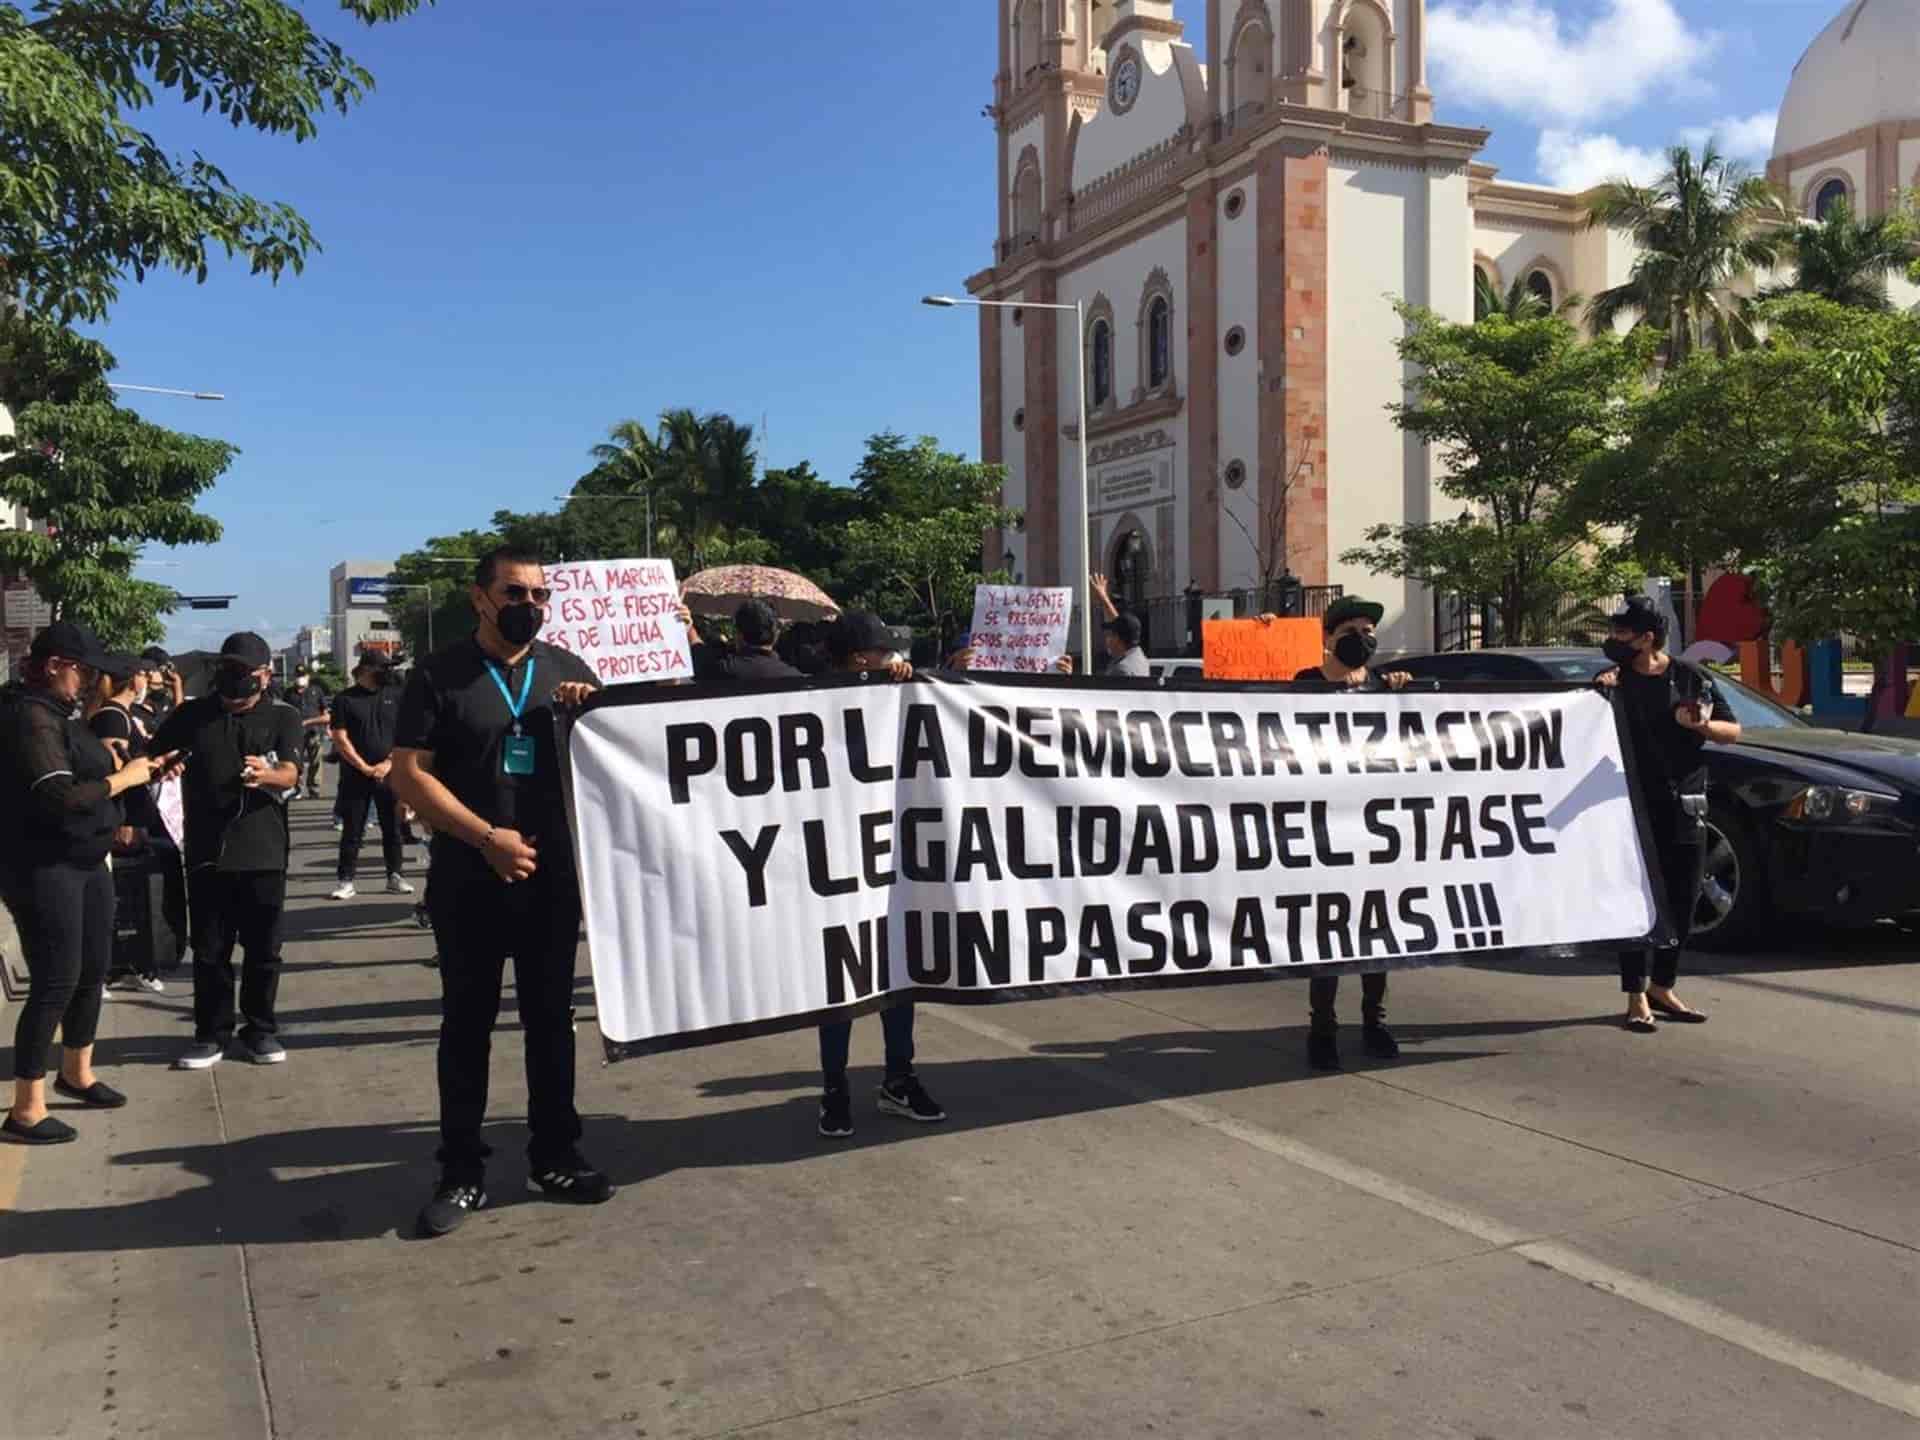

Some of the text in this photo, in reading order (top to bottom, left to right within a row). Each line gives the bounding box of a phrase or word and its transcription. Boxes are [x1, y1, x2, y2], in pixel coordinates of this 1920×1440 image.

[606, 567, 668, 590] MARCHA
[562, 599, 586, 623] ES
[592, 596, 616, 621] DE
[624, 594, 679, 617] FIESTA
[578, 626, 600, 649] DE
[612, 621, 664, 646] LUCHA
[597, 650, 687, 678] PROTESTA
[667, 704, 1566, 804] POR LA DEMOCRATIZACION
[719, 793, 1556, 907] Y LEGALIDAD DEL STASE
[822, 915, 888, 1004] NI
[905, 909, 1010, 987] UN
[1027, 899, 1213, 981] PASO
